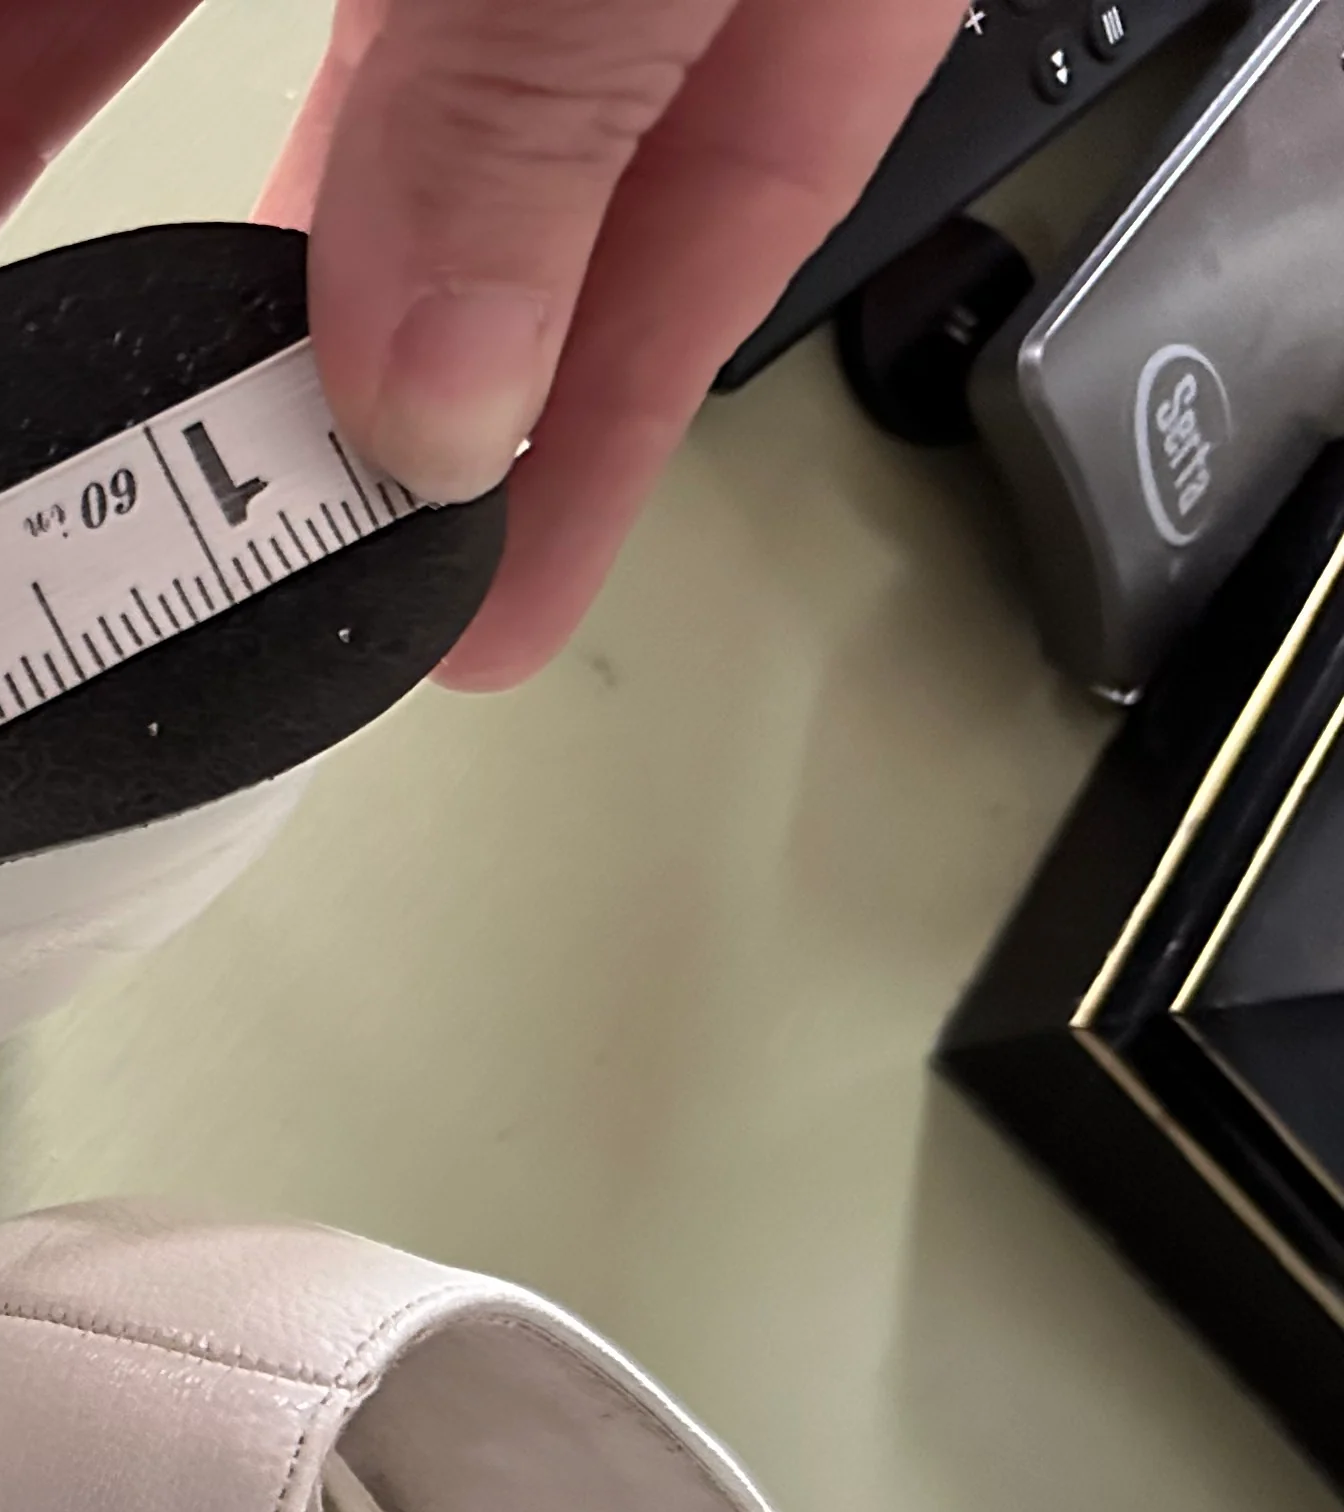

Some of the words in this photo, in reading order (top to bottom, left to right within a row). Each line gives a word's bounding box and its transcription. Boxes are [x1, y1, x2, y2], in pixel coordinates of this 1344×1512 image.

[182, 421, 269, 527] 1
[1156, 373, 1211, 516] Serta
[81, 467, 137, 530] 60
